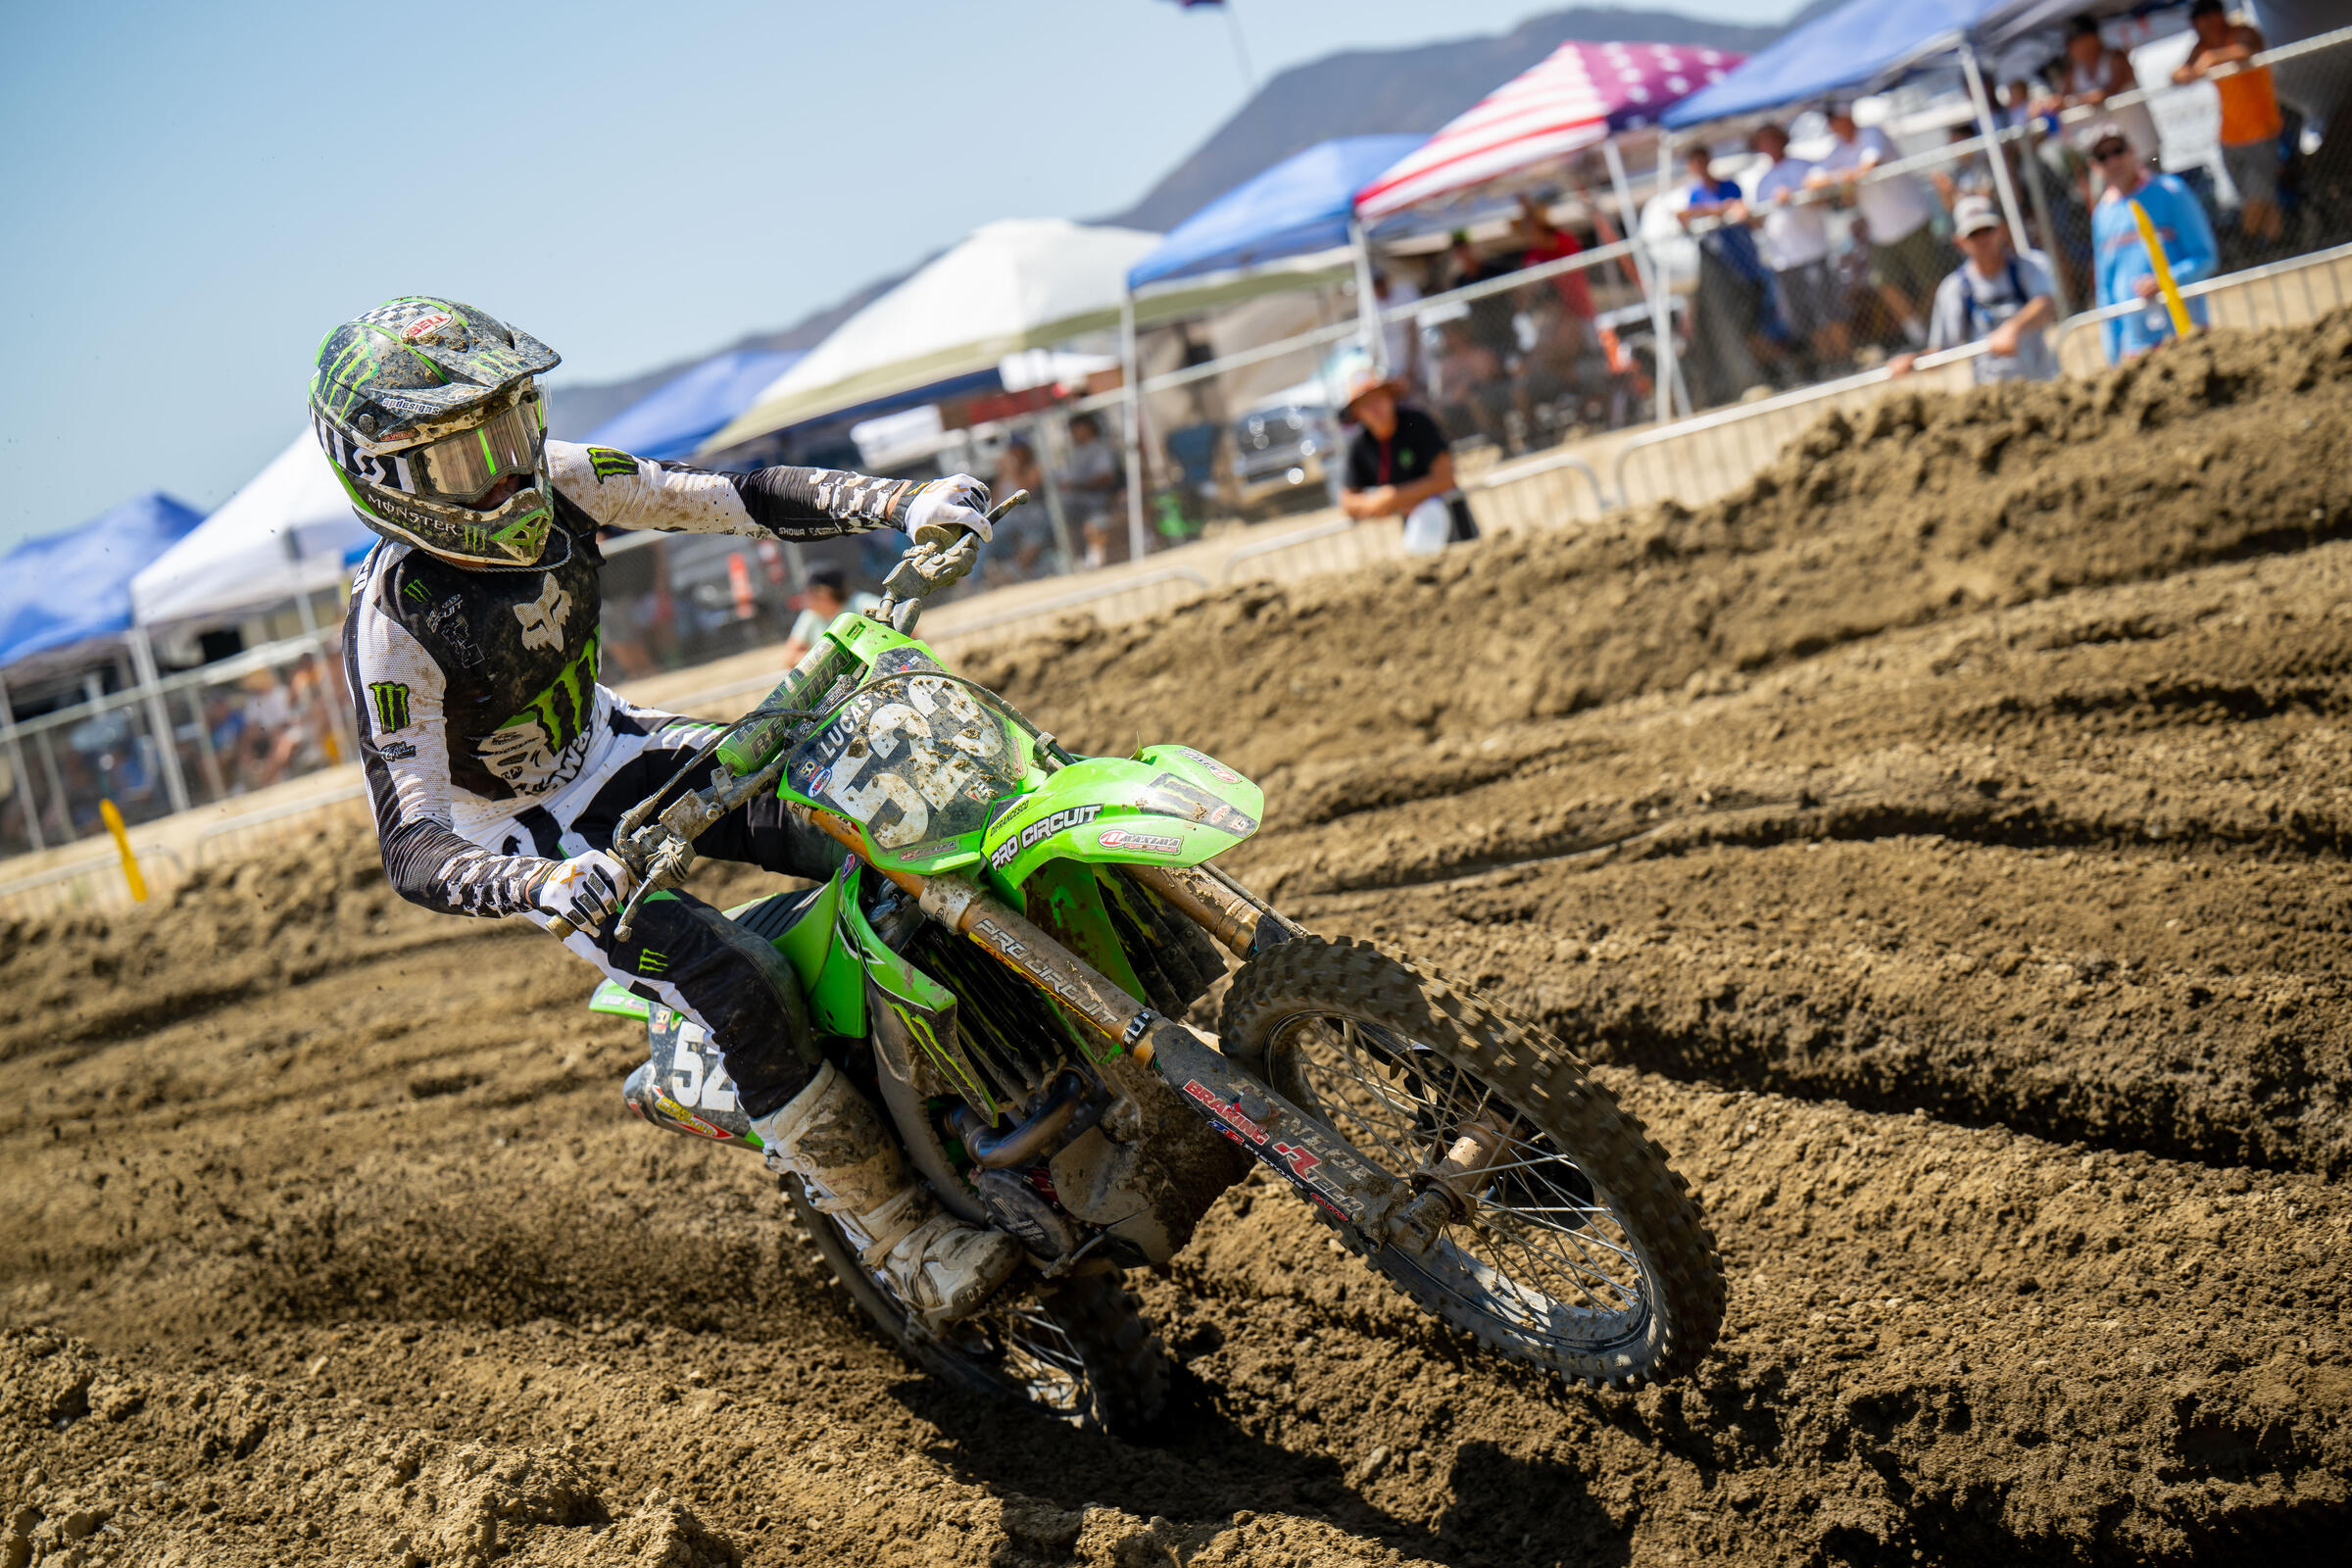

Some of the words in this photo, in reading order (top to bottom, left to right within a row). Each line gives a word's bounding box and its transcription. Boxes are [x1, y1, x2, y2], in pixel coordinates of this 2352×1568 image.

[408, 315, 448, 337] BELL
[382, 398, 440, 416] apdesigns
[779, 527, 806, 536] SHOWA
[819, 694, 872, 760] LUCAS
[800, 760, 815, 777] 50
[824, 675, 1003, 849] 523
[991, 835, 1019, 872] PRO
[1021, 804, 1104, 851] CIRCUIT
[976, 917, 1028, 960] PRO
[1024, 960, 1120, 1025] CIRCUIT
[1183, 1079, 1270, 1146] BRAKING
